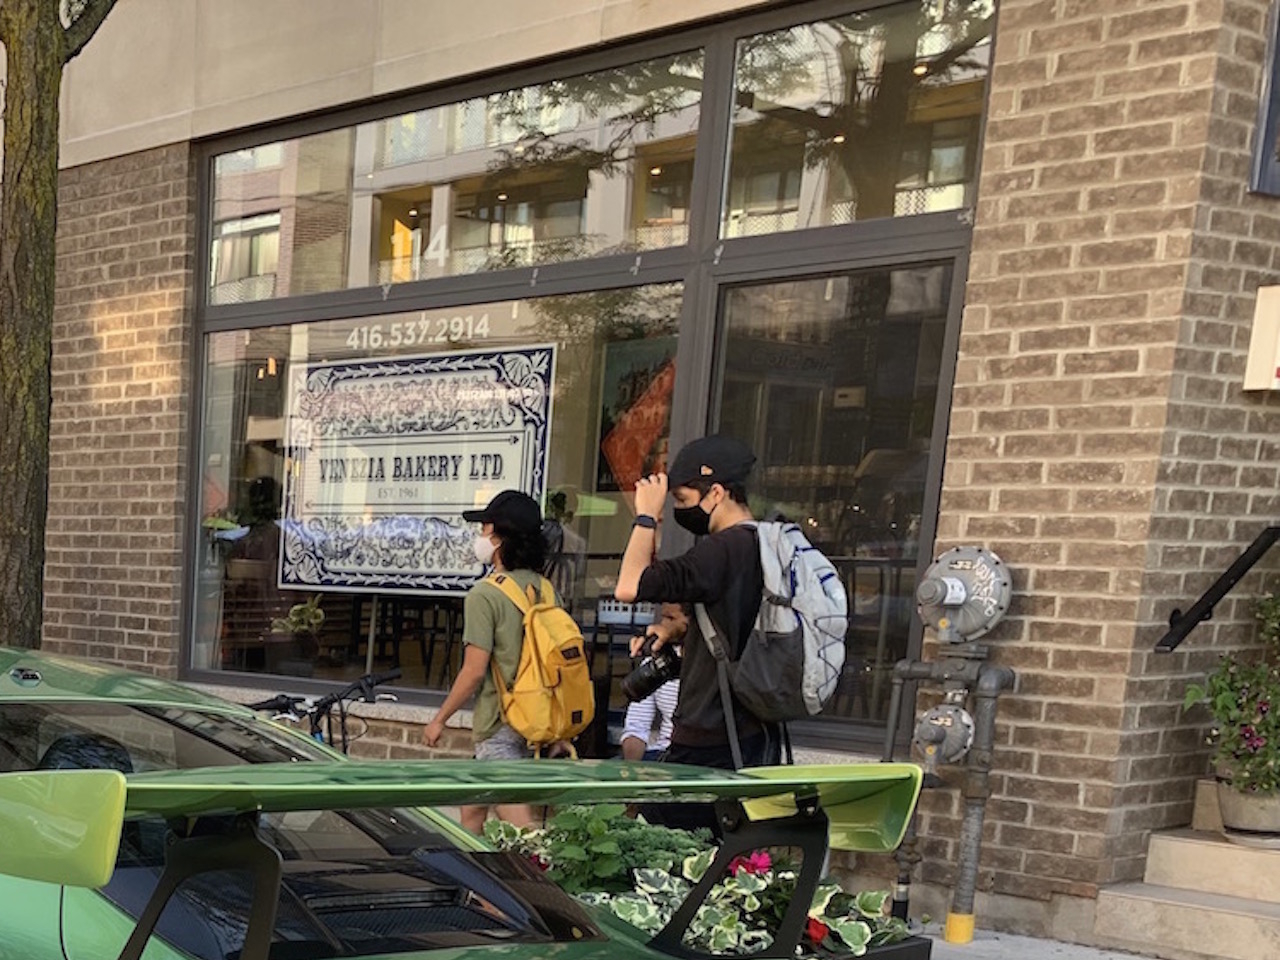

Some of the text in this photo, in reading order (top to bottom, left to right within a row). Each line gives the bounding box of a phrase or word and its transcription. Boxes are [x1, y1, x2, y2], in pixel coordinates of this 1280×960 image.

[346, 313, 490, 350] 416.537.2914
[320, 457, 386, 483] VENEZIA
[393, 455, 463, 481] BAKERY
[399, 487, 419, 498] 1961
